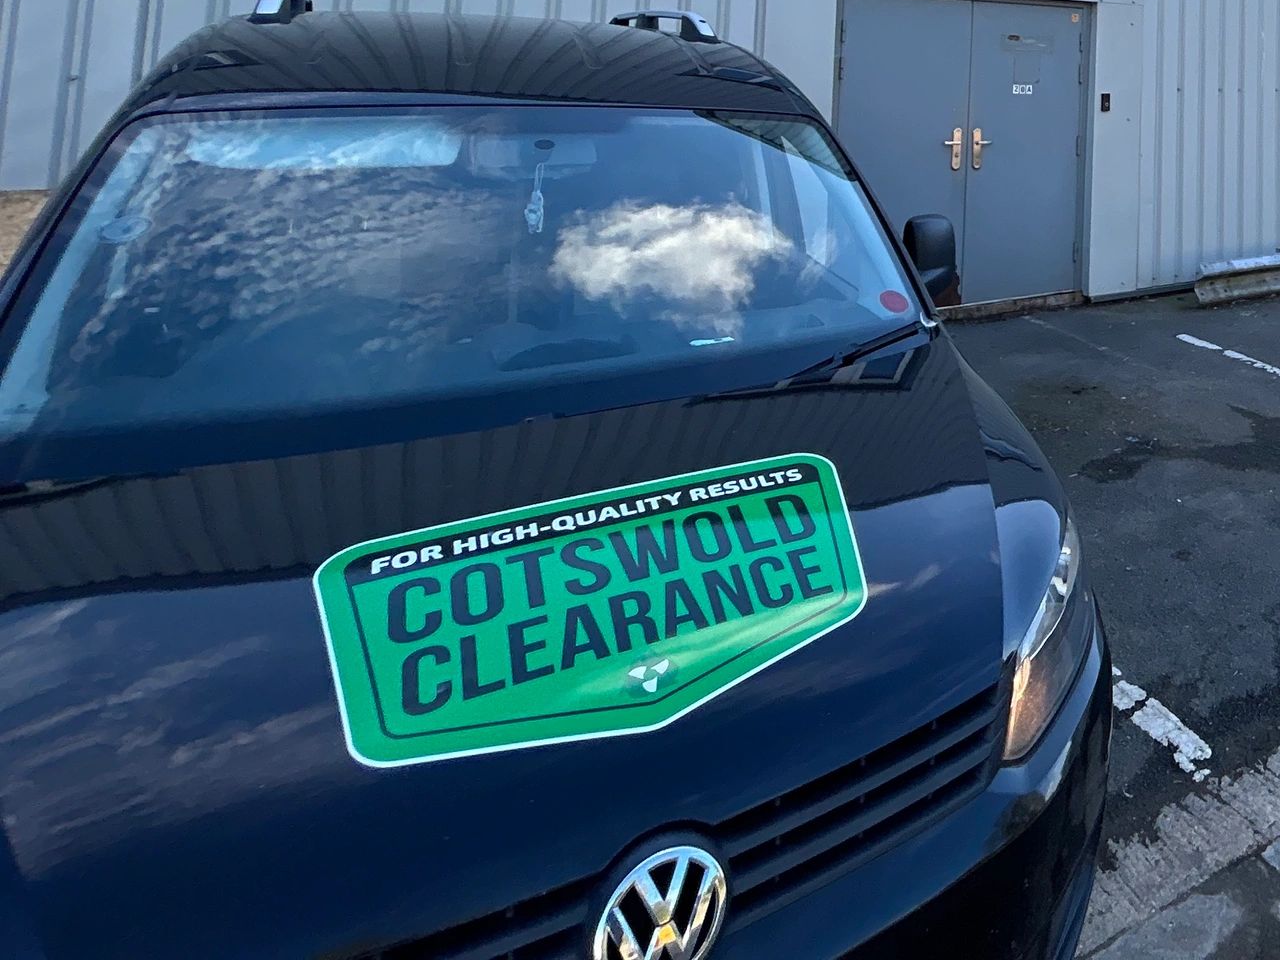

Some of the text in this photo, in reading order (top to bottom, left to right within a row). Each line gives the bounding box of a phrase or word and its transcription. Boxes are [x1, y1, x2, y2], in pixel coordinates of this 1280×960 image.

[370, 468, 802, 575] FOR HIGH-QUALITY RESULTS
[387, 493, 817, 644] COTSWOLD
[401, 546, 834, 716] CLEARANCE
